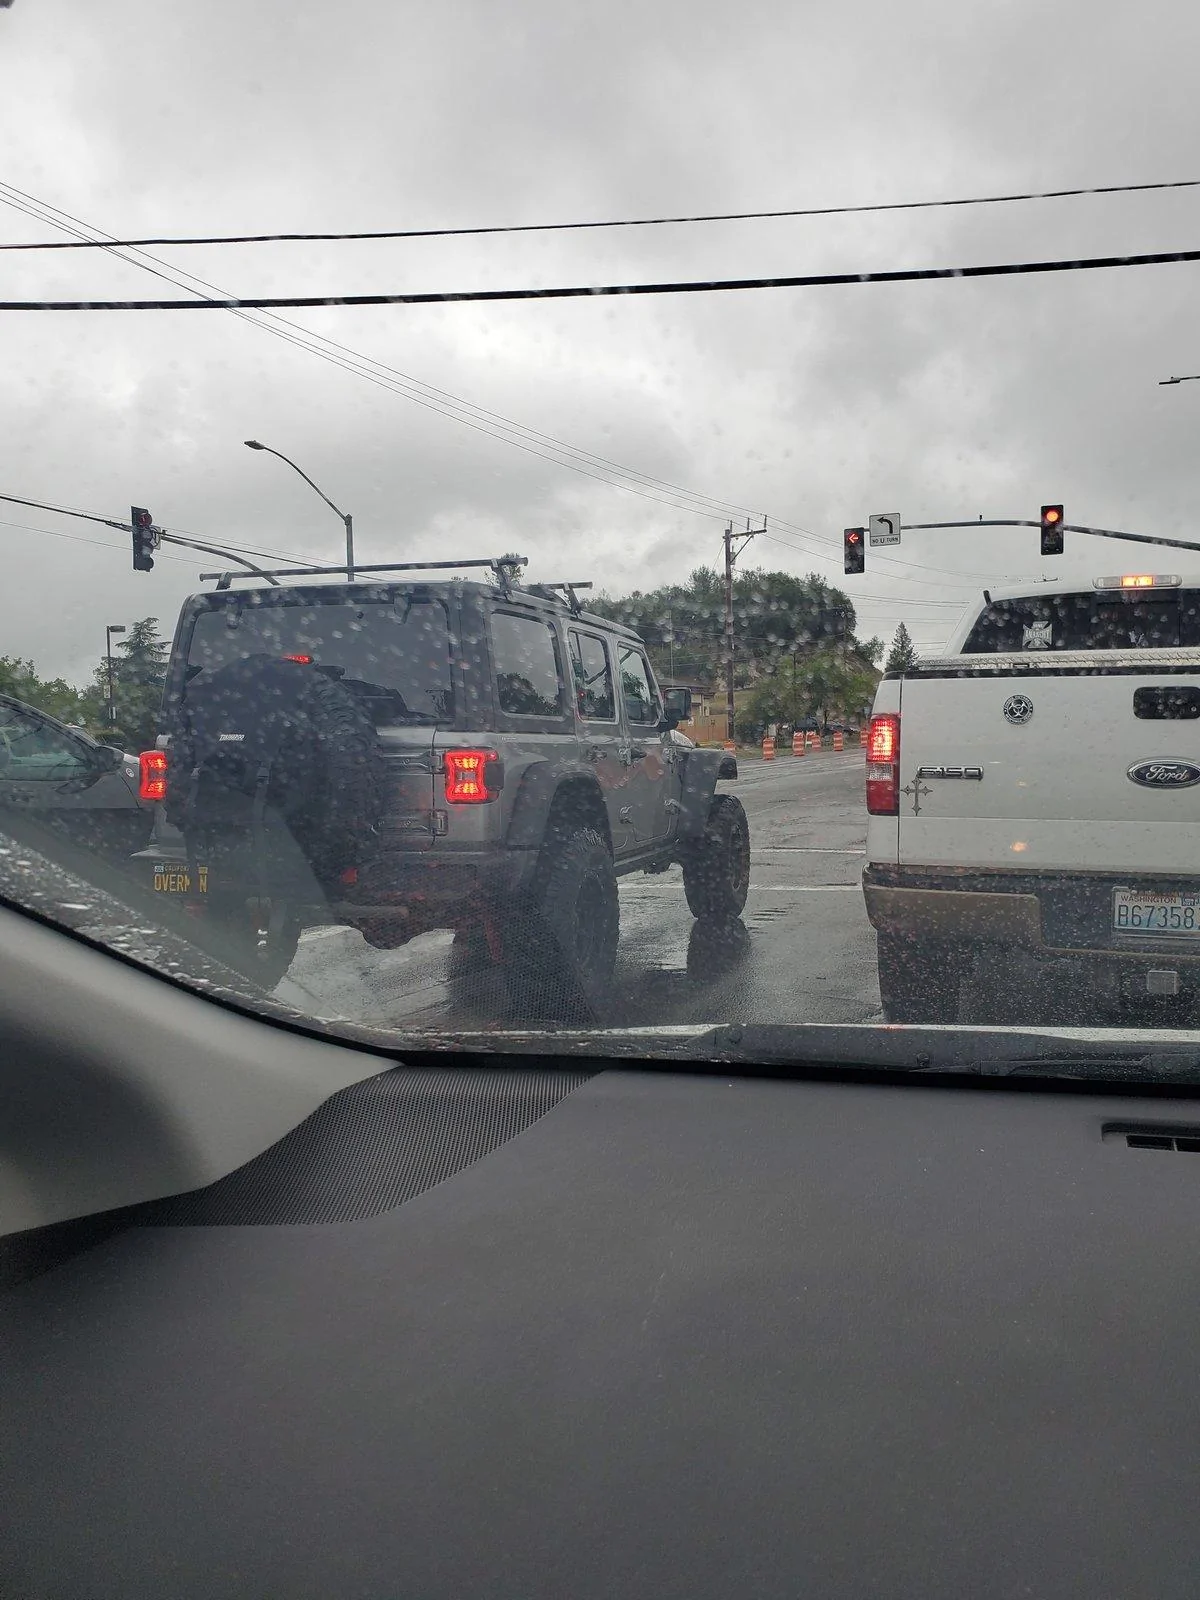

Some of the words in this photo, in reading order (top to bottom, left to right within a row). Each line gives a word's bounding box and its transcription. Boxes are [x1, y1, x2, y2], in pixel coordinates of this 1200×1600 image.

[1146, 765, 1189, 780] Ford
[1120, 894, 1177, 904] WASHINGTON
[1117, 904, 1200, 929] B67358
